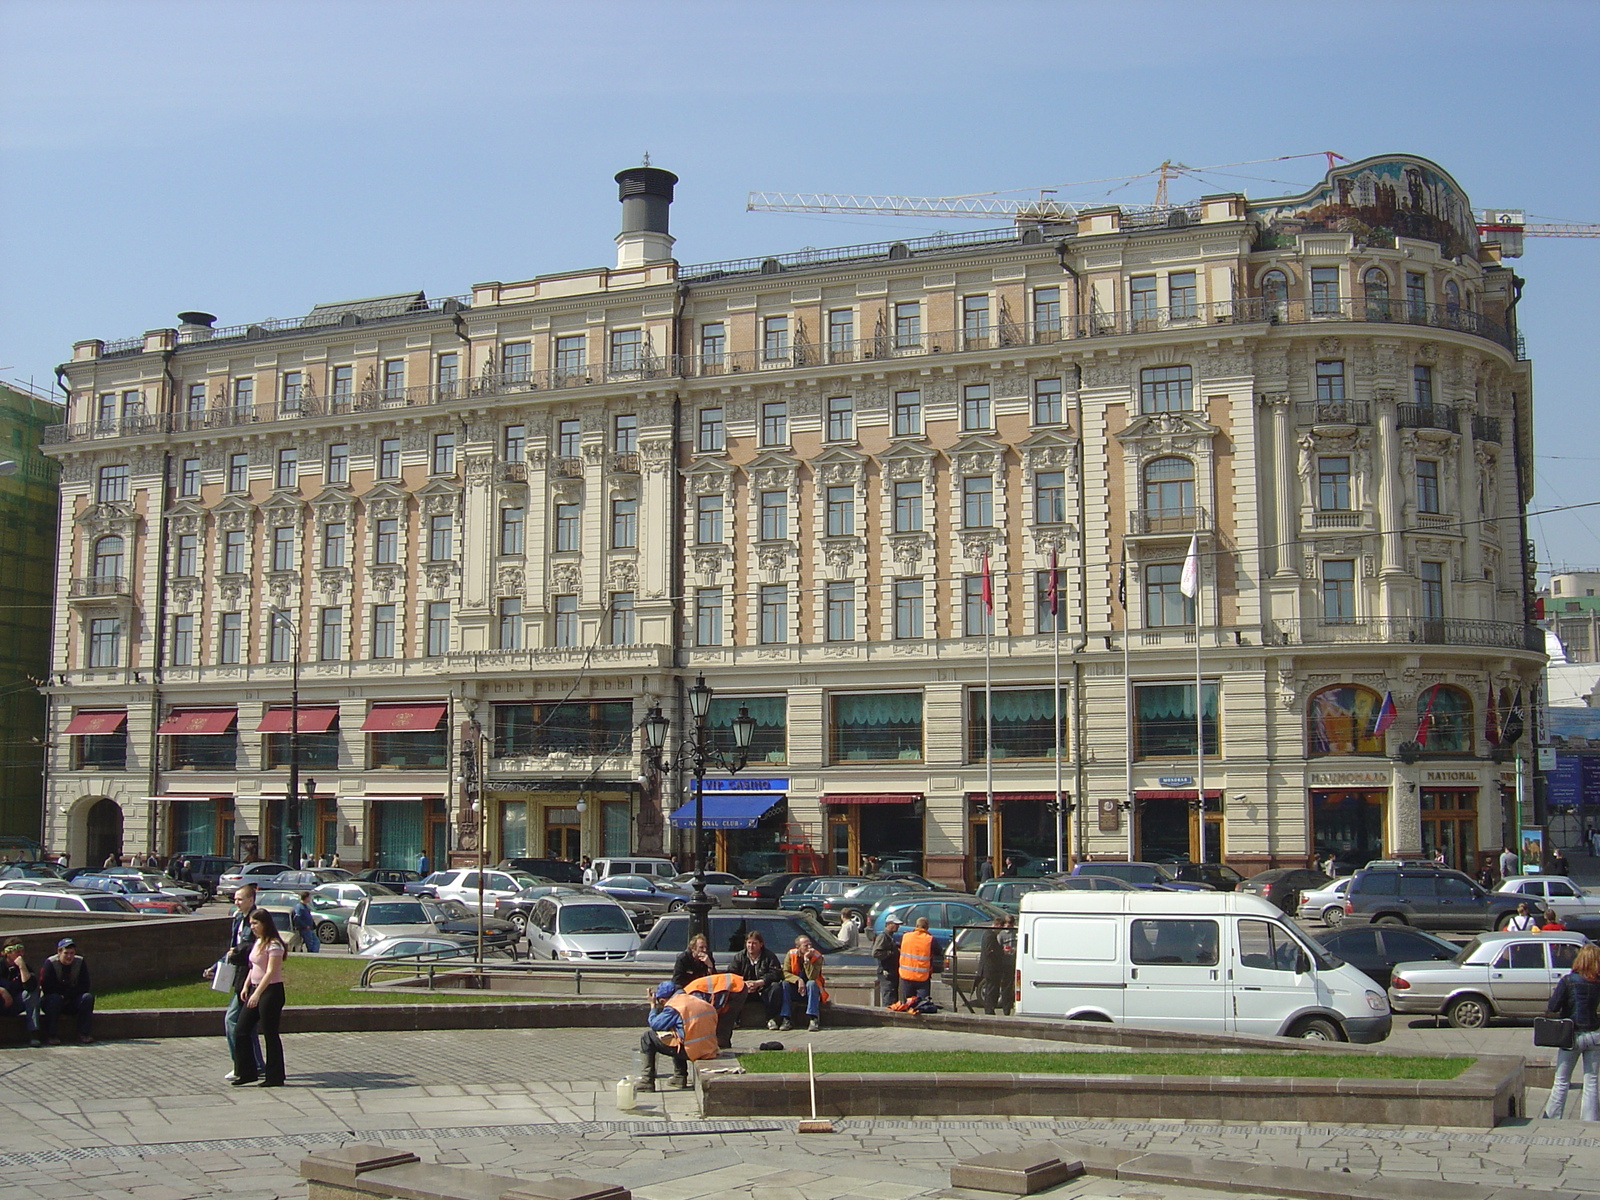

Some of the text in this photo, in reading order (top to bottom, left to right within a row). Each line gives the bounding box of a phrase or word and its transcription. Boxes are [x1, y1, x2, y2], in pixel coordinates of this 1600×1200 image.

[1427, 771, 1477, 781] NATIONAL
[705, 780, 771, 790] VIP CASINO
